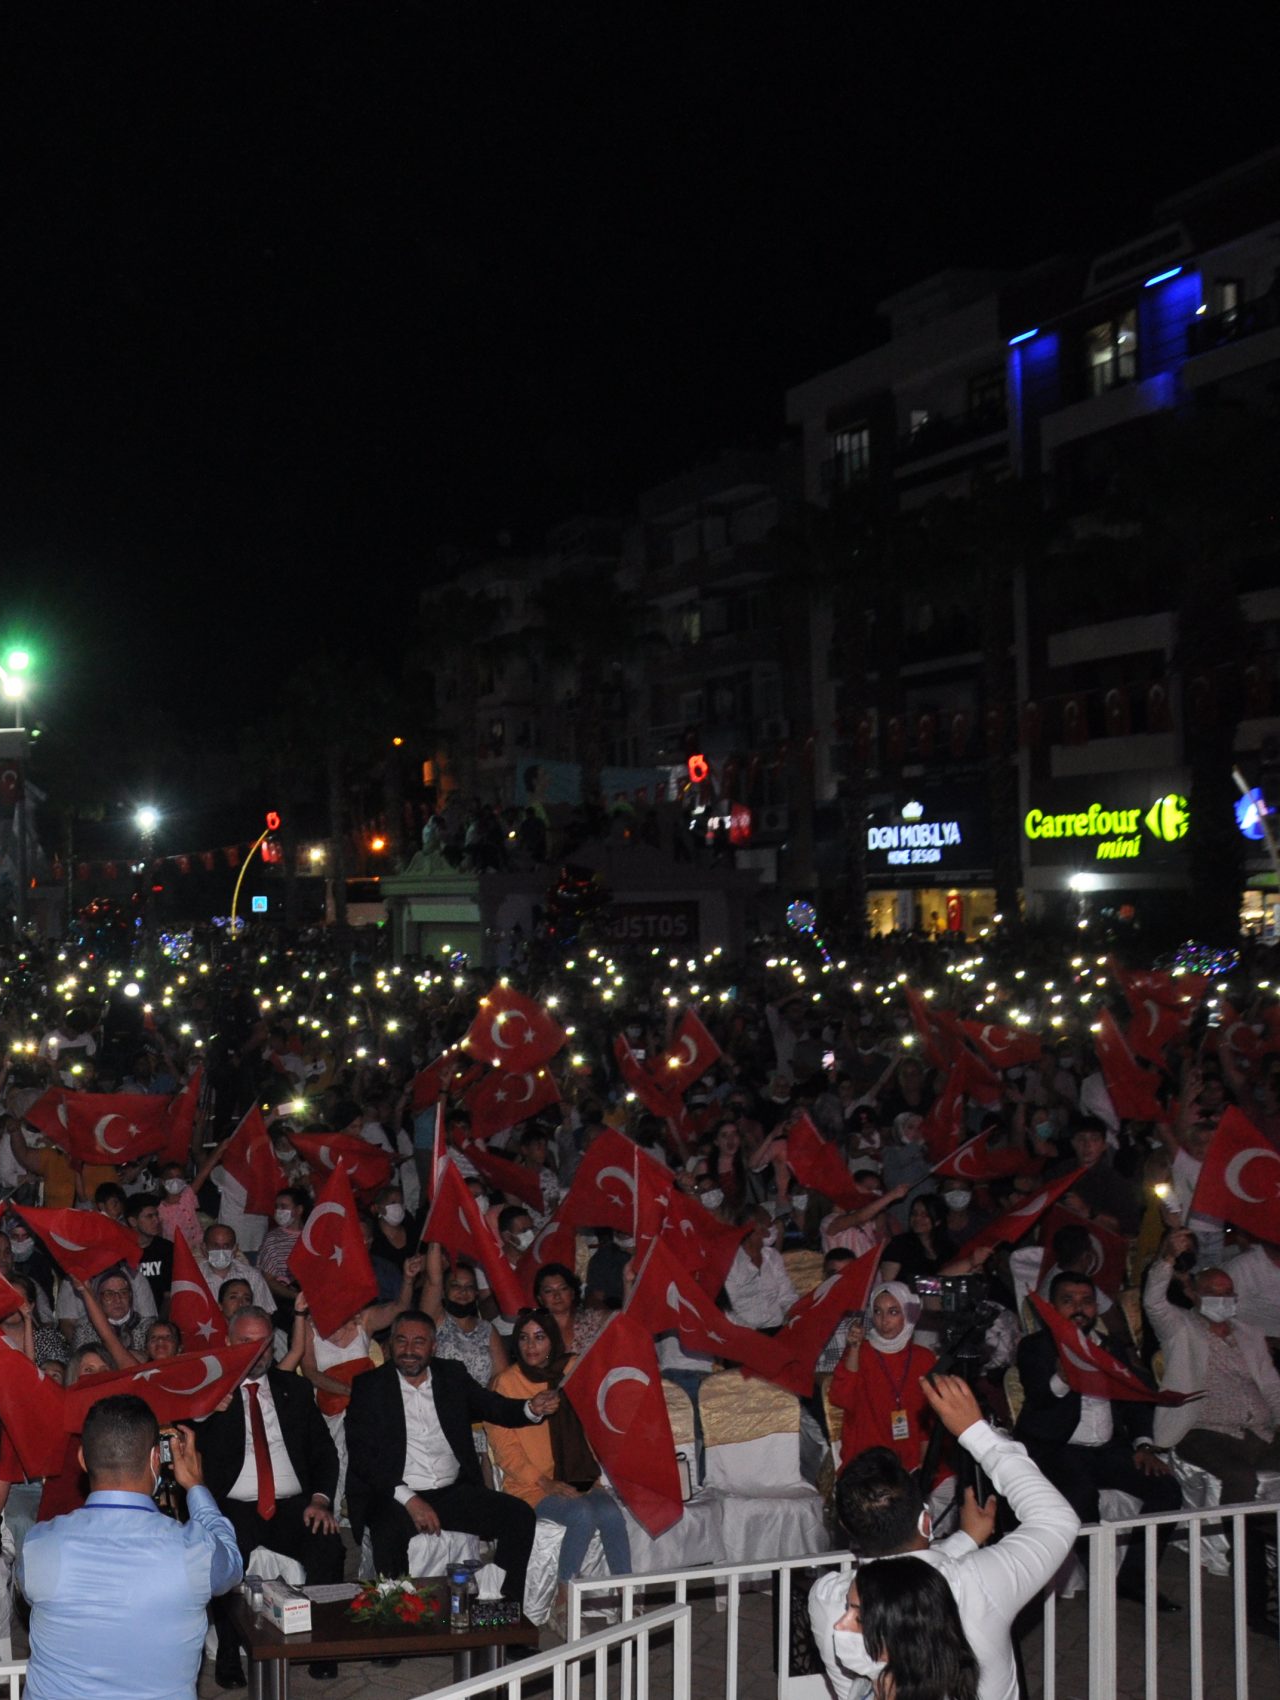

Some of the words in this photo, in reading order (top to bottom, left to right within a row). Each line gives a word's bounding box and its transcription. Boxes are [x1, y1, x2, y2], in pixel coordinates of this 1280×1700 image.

[1025, 803, 1141, 840] Carrefour
[868, 827, 899, 850] DGN
[1096, 834, 1142, 860] mini
[610, 914, 688, 938] USTOS
[140, 1261, 162, 1276] CKY
